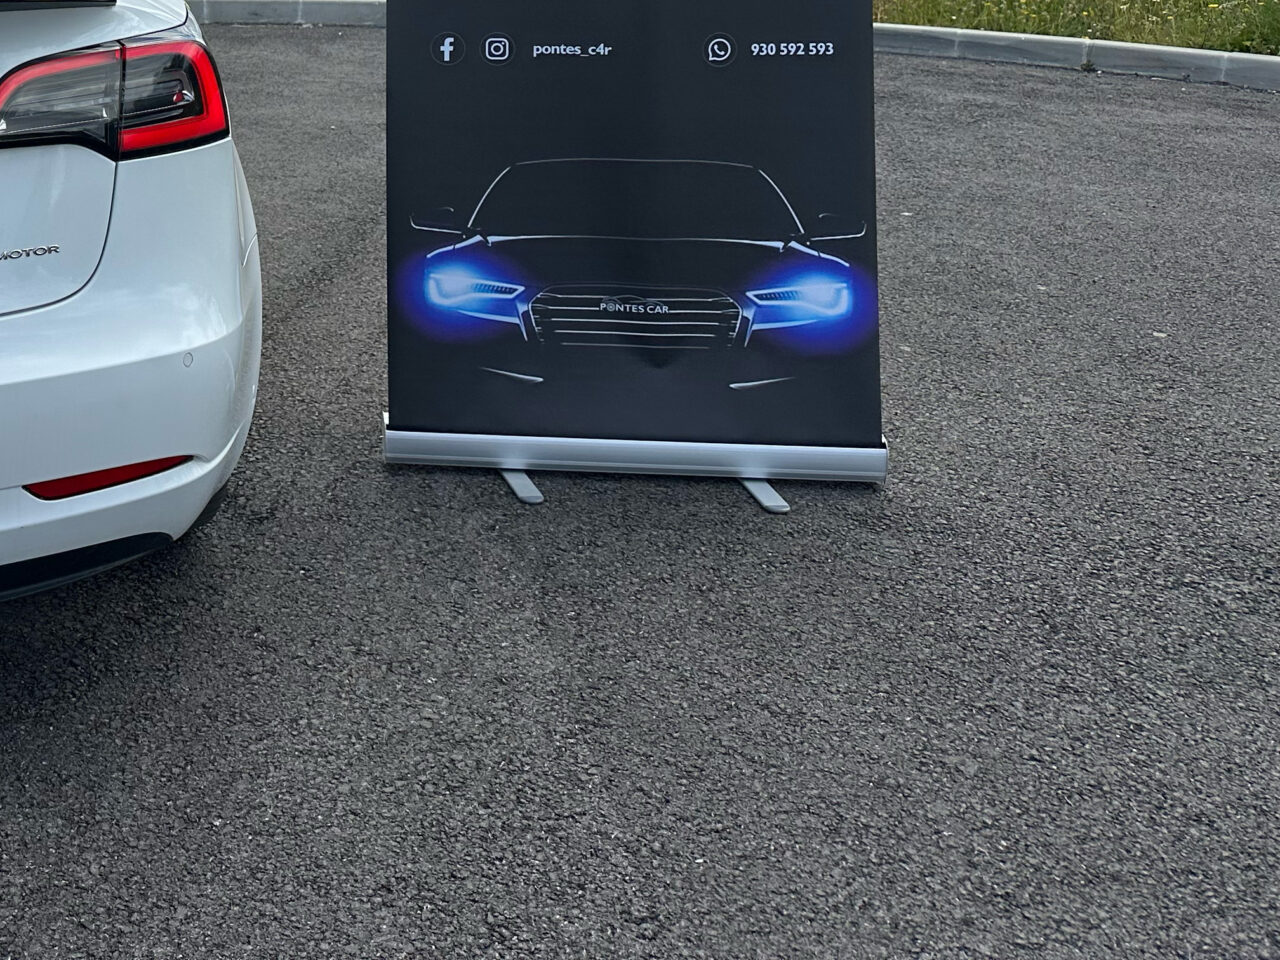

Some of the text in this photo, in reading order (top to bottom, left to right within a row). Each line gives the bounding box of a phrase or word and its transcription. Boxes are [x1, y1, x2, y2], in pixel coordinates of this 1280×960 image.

[533, 43, 612, 57] pontes_c4r
[751, 42, 834, 55] 930 592 593
[600, 302, 669, 314] PONTES CAR
